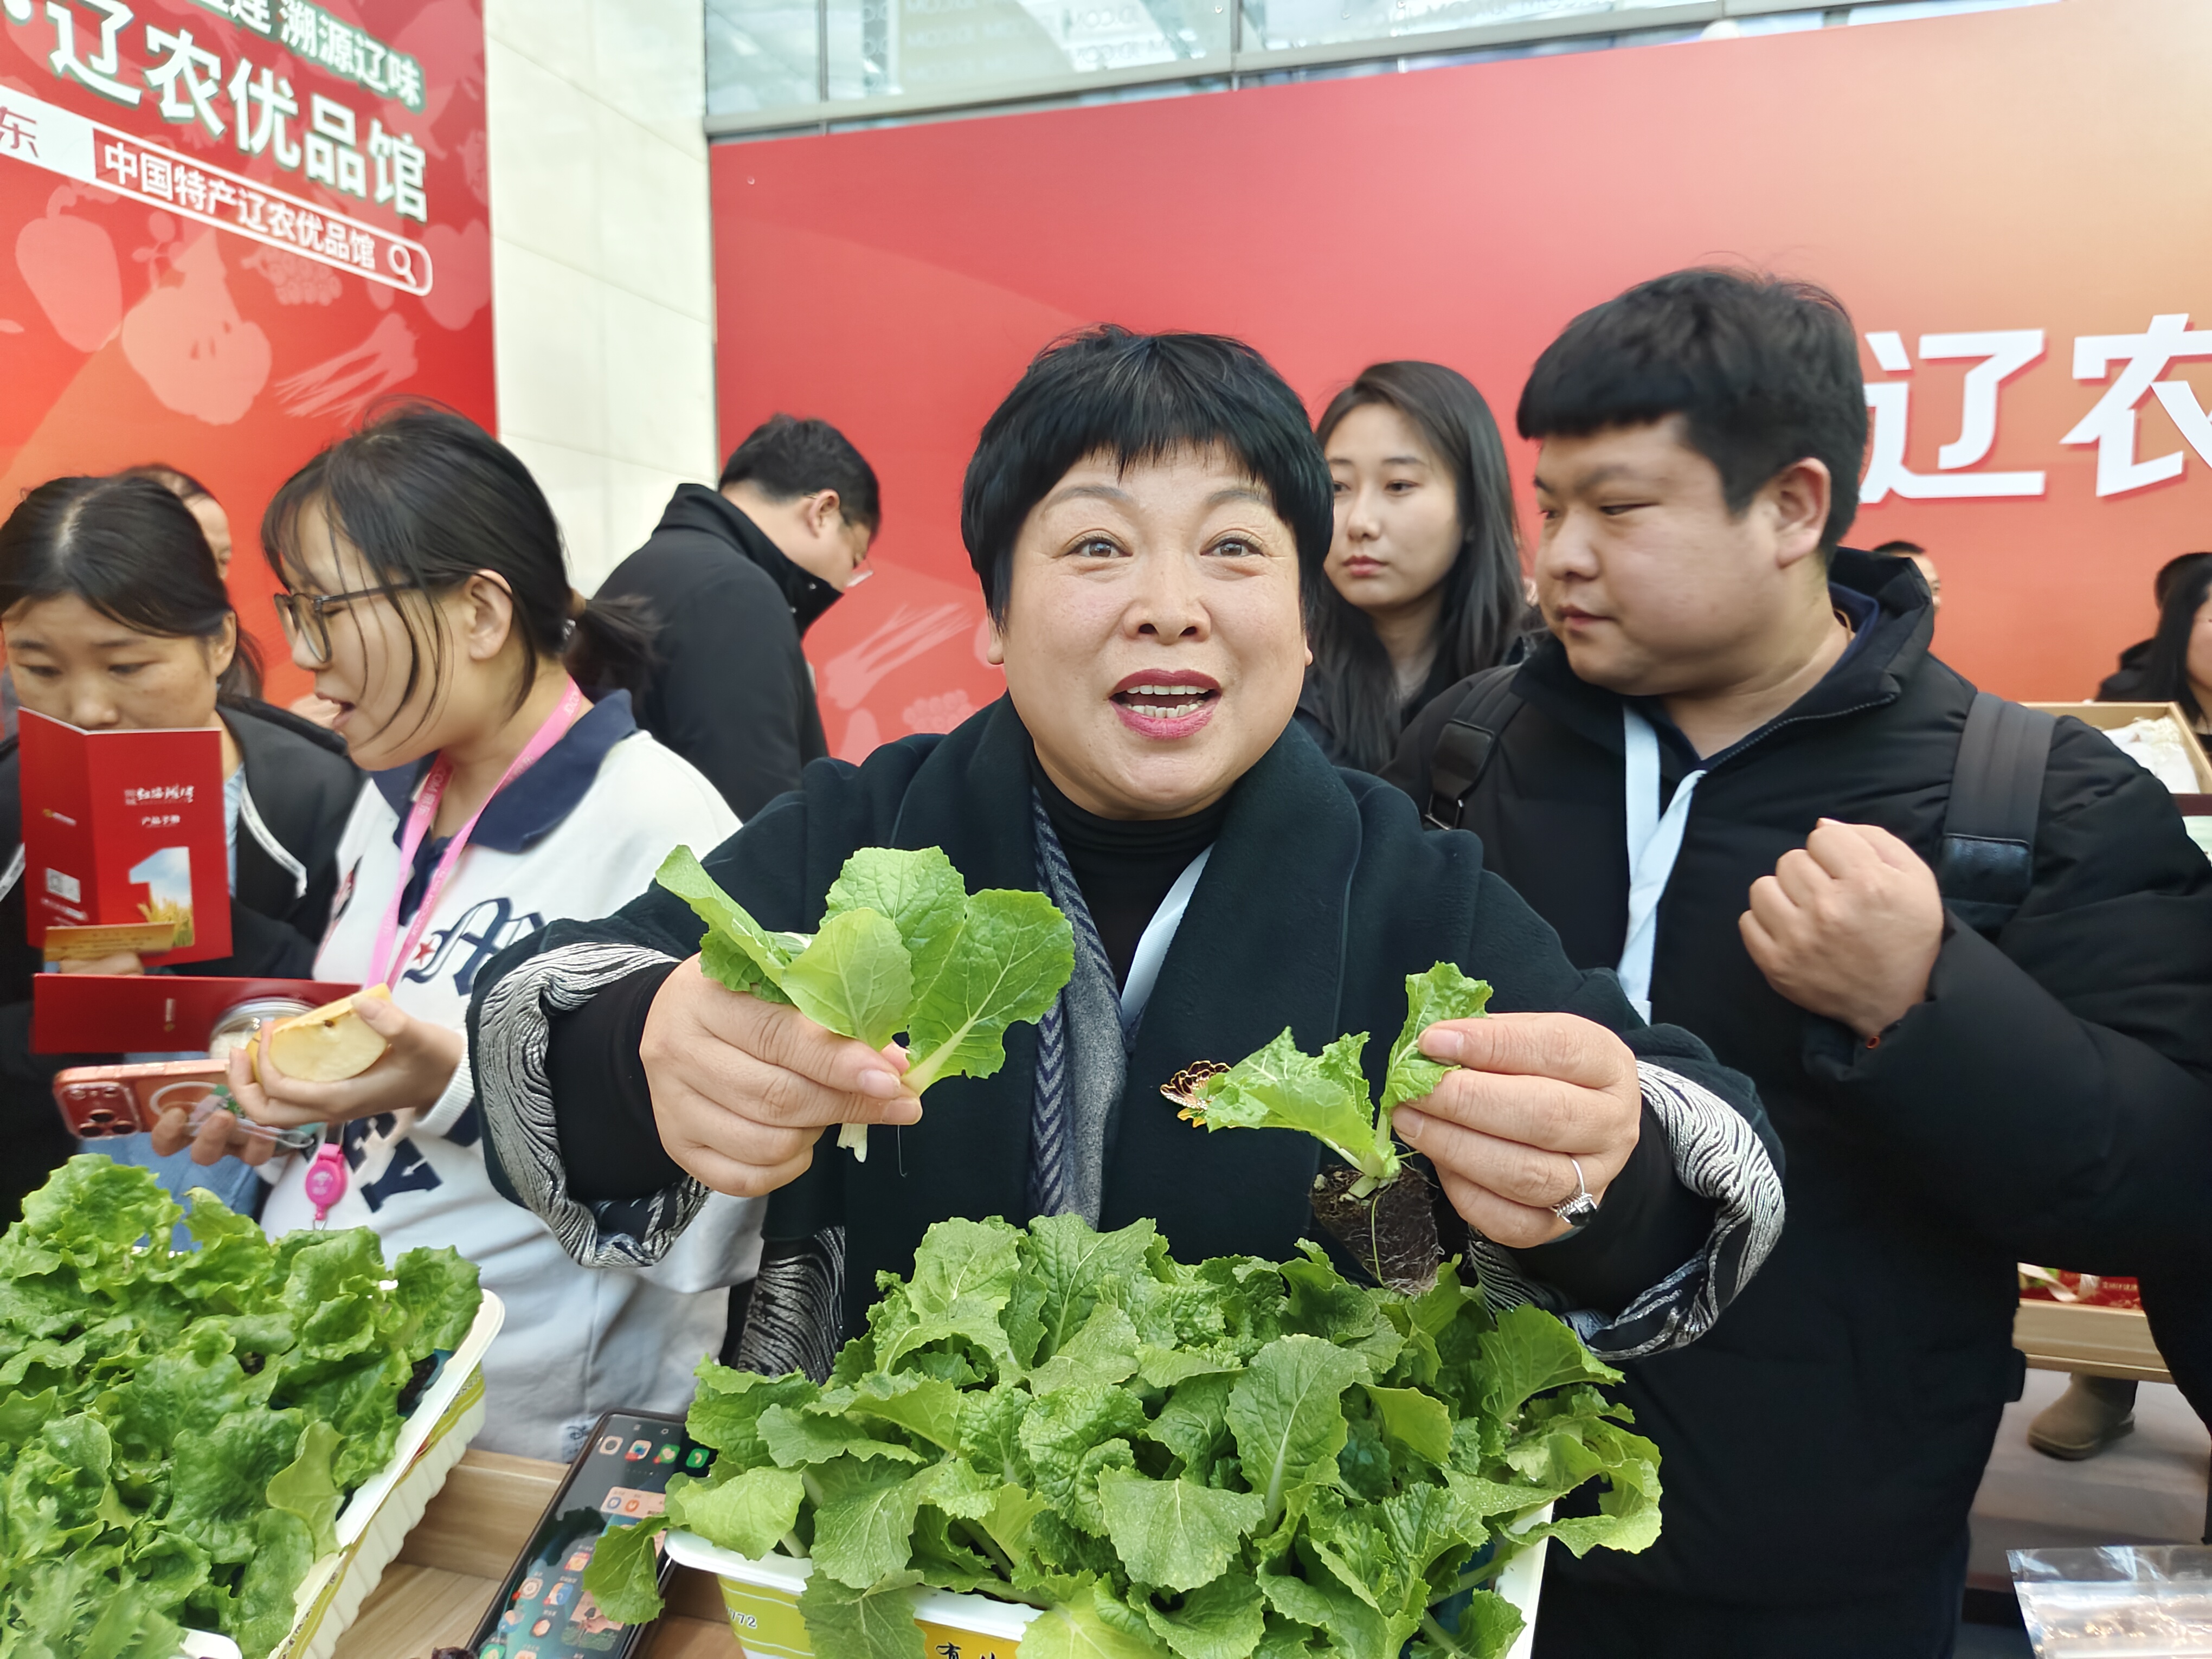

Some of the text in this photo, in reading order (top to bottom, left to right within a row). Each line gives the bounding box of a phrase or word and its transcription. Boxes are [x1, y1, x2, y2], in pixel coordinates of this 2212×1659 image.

[46, 0, 427, 223] 辽农优品馆
[279, 0, 421, 106] 溯源辽味
[105, 142, 376, 270] 中国特产辽农优品馆
[1860, 313, 2212, 504] 辽农
[726, 1606, 757, 1629] 772
